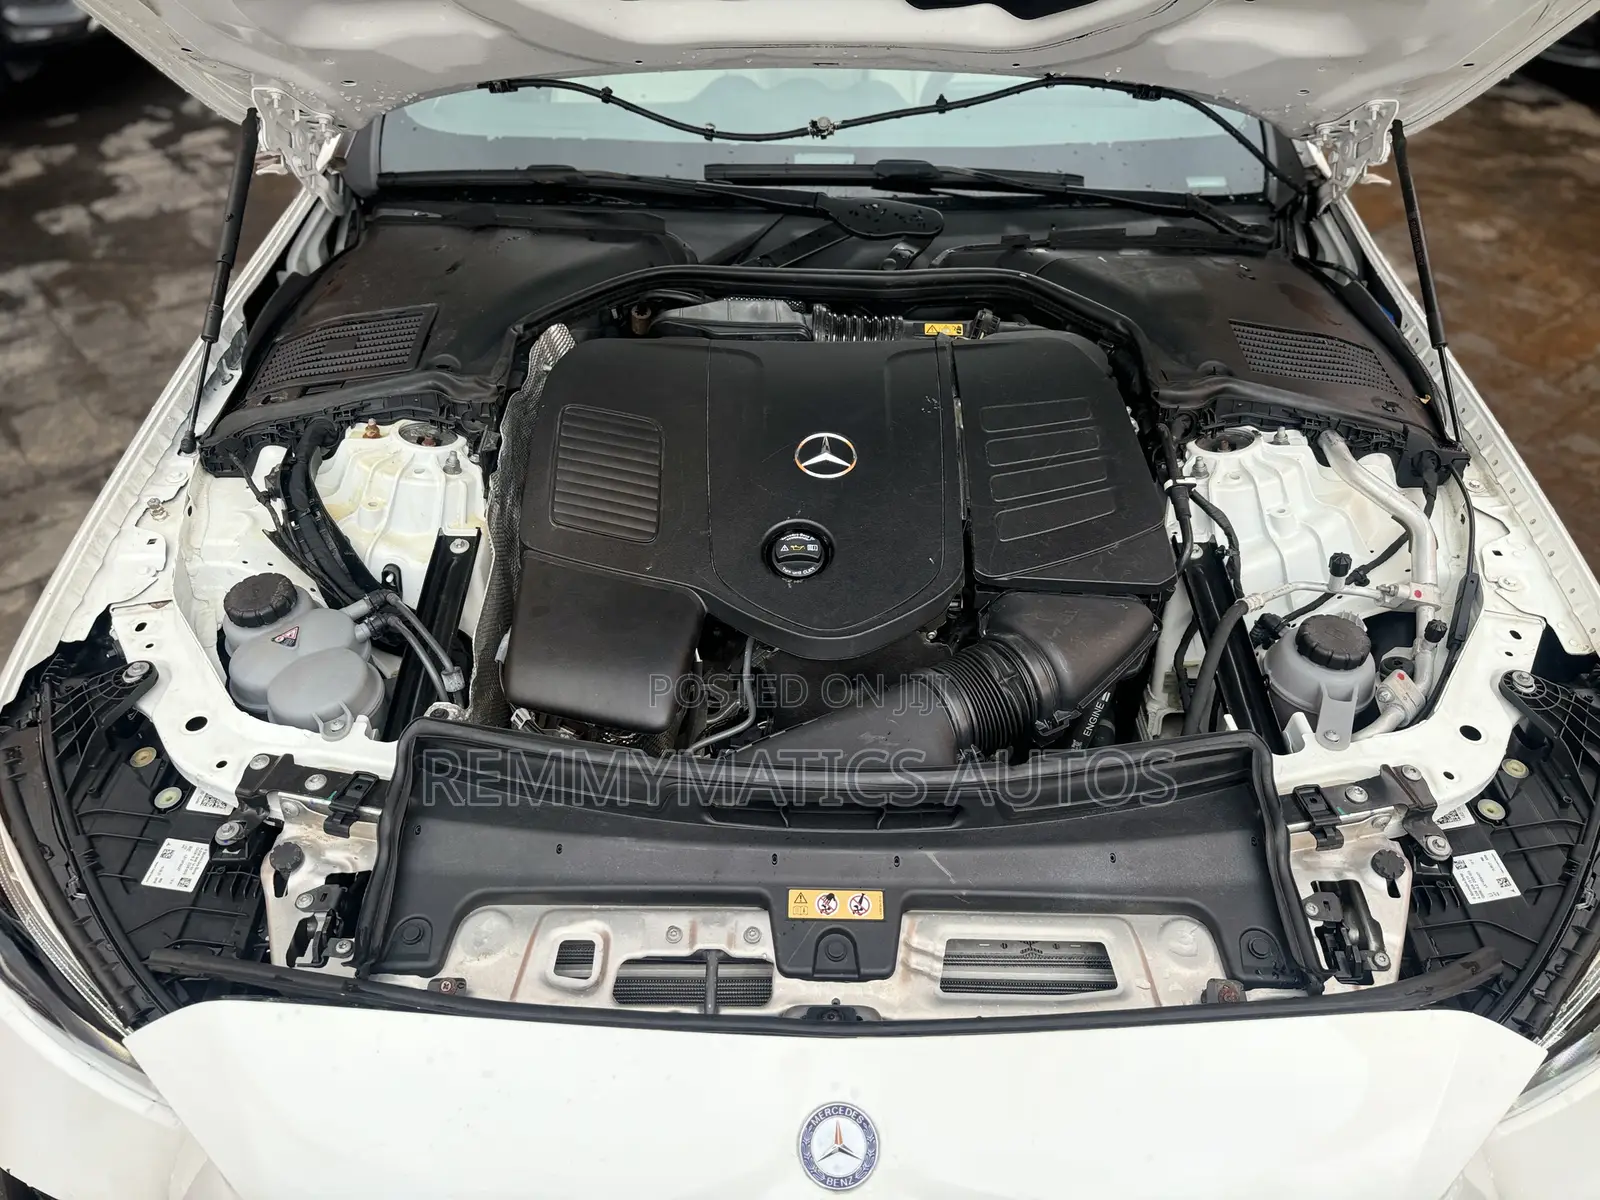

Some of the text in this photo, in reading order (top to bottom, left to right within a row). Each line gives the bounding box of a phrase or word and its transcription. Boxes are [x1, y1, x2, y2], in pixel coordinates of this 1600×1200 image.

[1083, 701, 1105, 737] ENGINE
[811, 1106, 864, 1126] MERCEDES
[826, 1177, 855, 1187] BENZ
